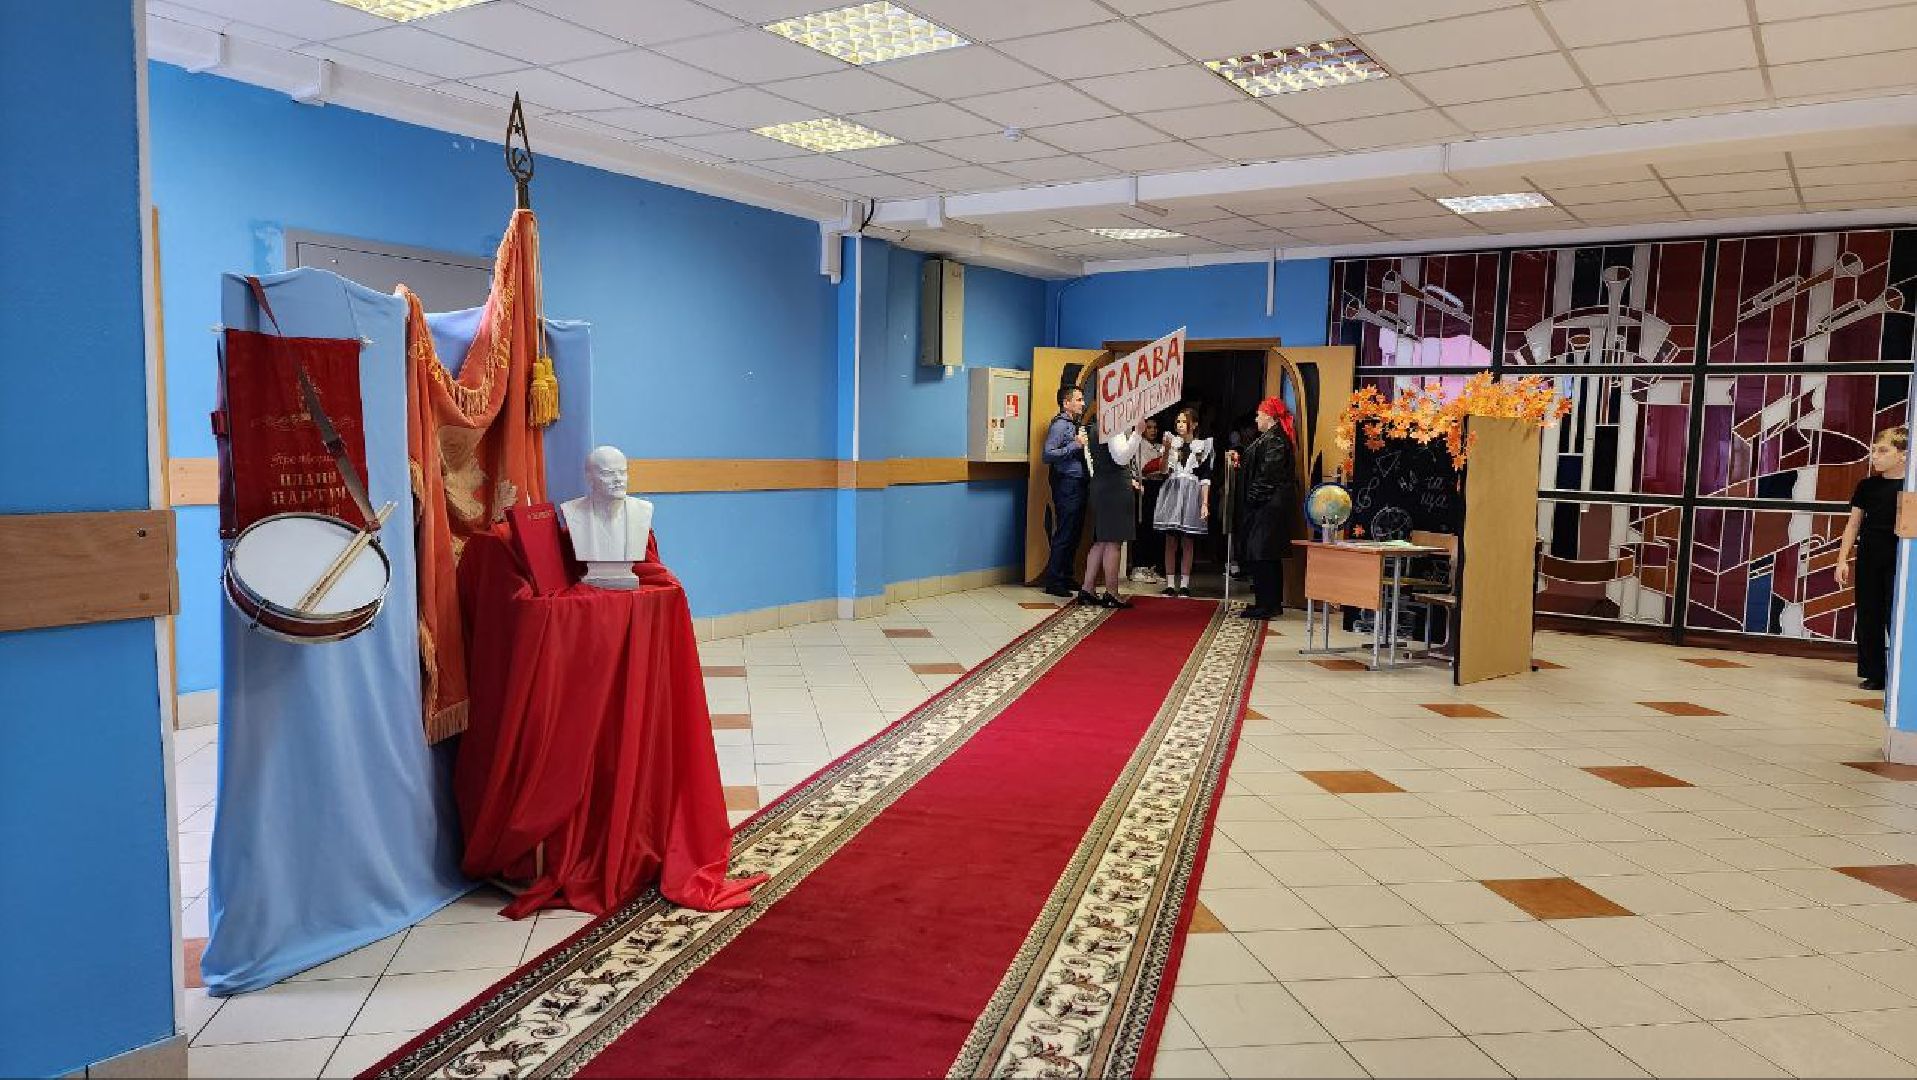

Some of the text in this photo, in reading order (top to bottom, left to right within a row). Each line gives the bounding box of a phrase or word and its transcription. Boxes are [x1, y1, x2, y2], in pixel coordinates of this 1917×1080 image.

[1102, 337, 1181, 403] СЛАВА
[280, 471, 338, 486] ПЛАНЫ
[272, 486, 346, 504] ПАРТИИ
